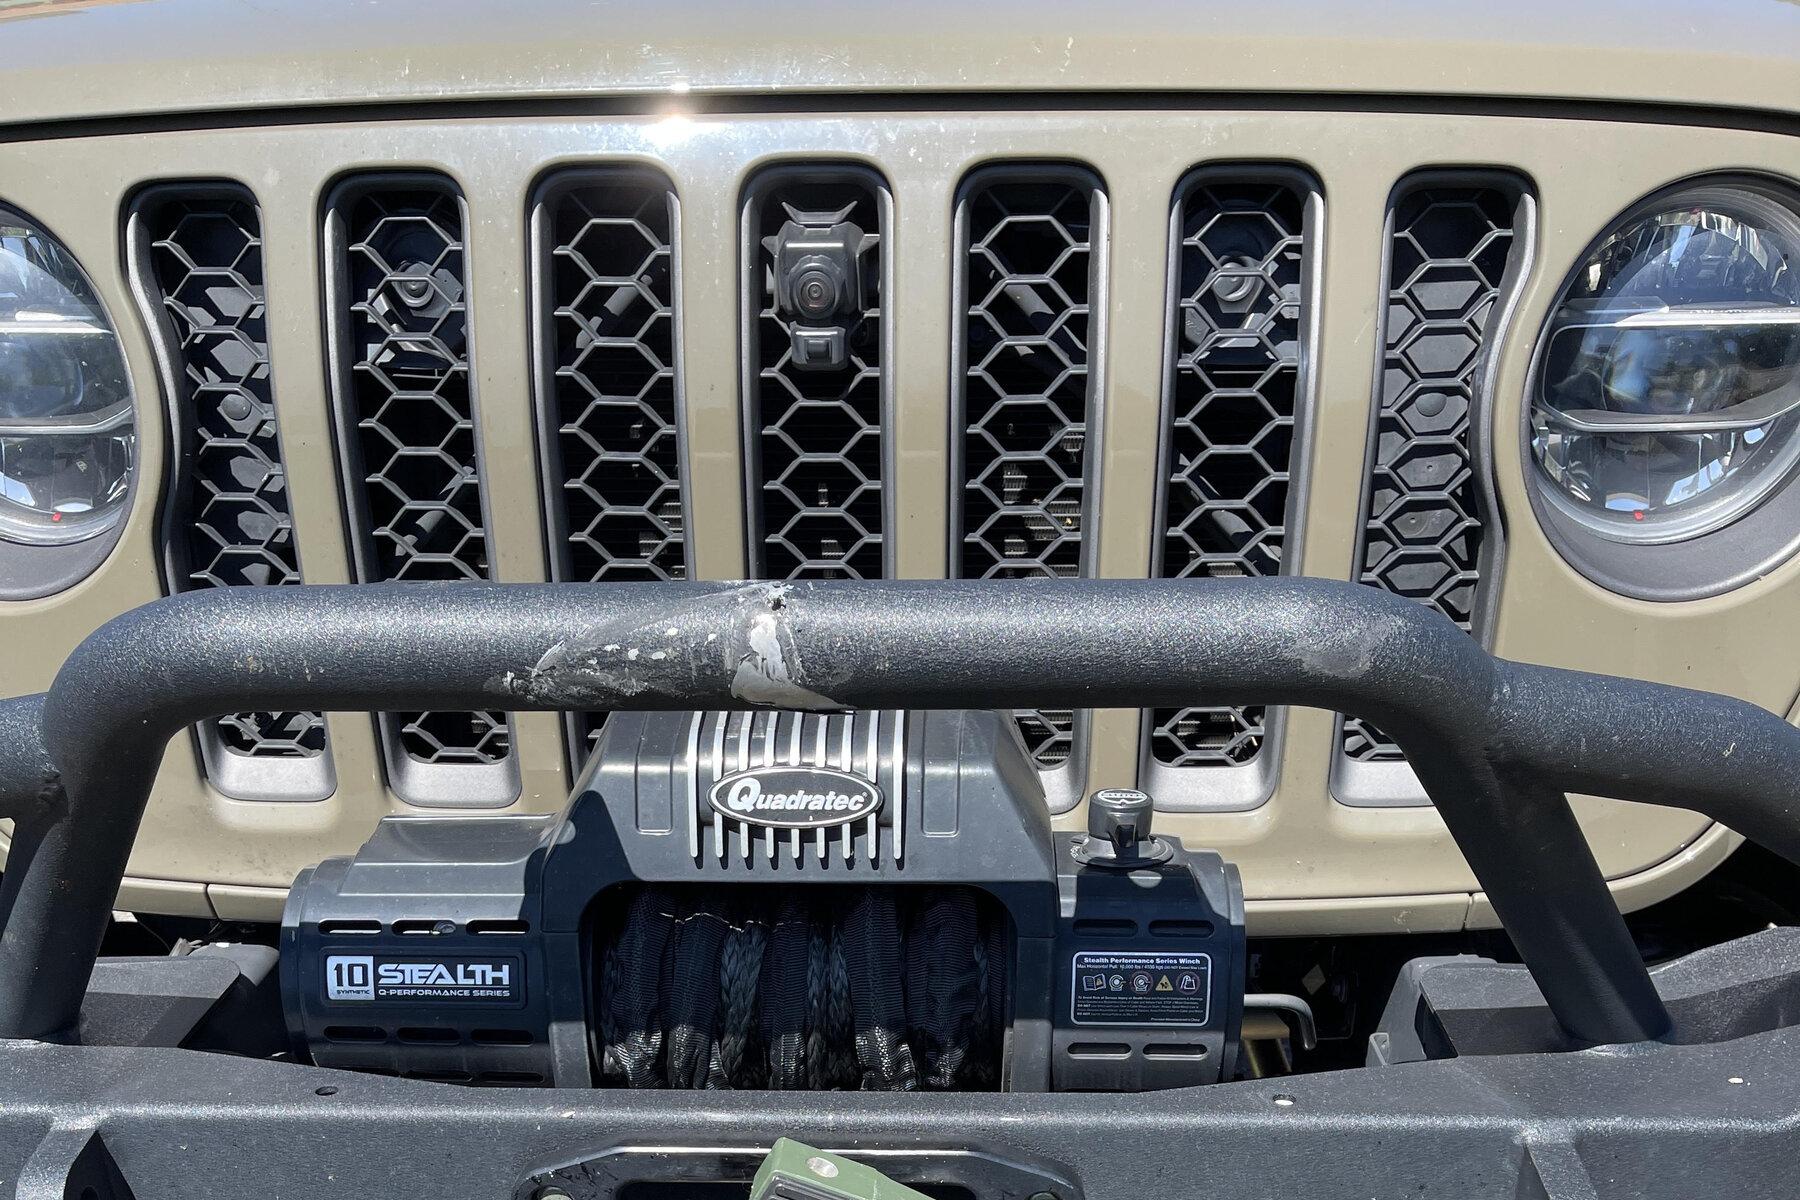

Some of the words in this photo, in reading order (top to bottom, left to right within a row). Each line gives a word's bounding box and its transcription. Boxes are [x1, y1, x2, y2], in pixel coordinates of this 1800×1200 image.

[727, 777, 866, 812] Quadratec
[333, 963, 369, 987] 10
[377, 964, 510, 985] STEALTH
